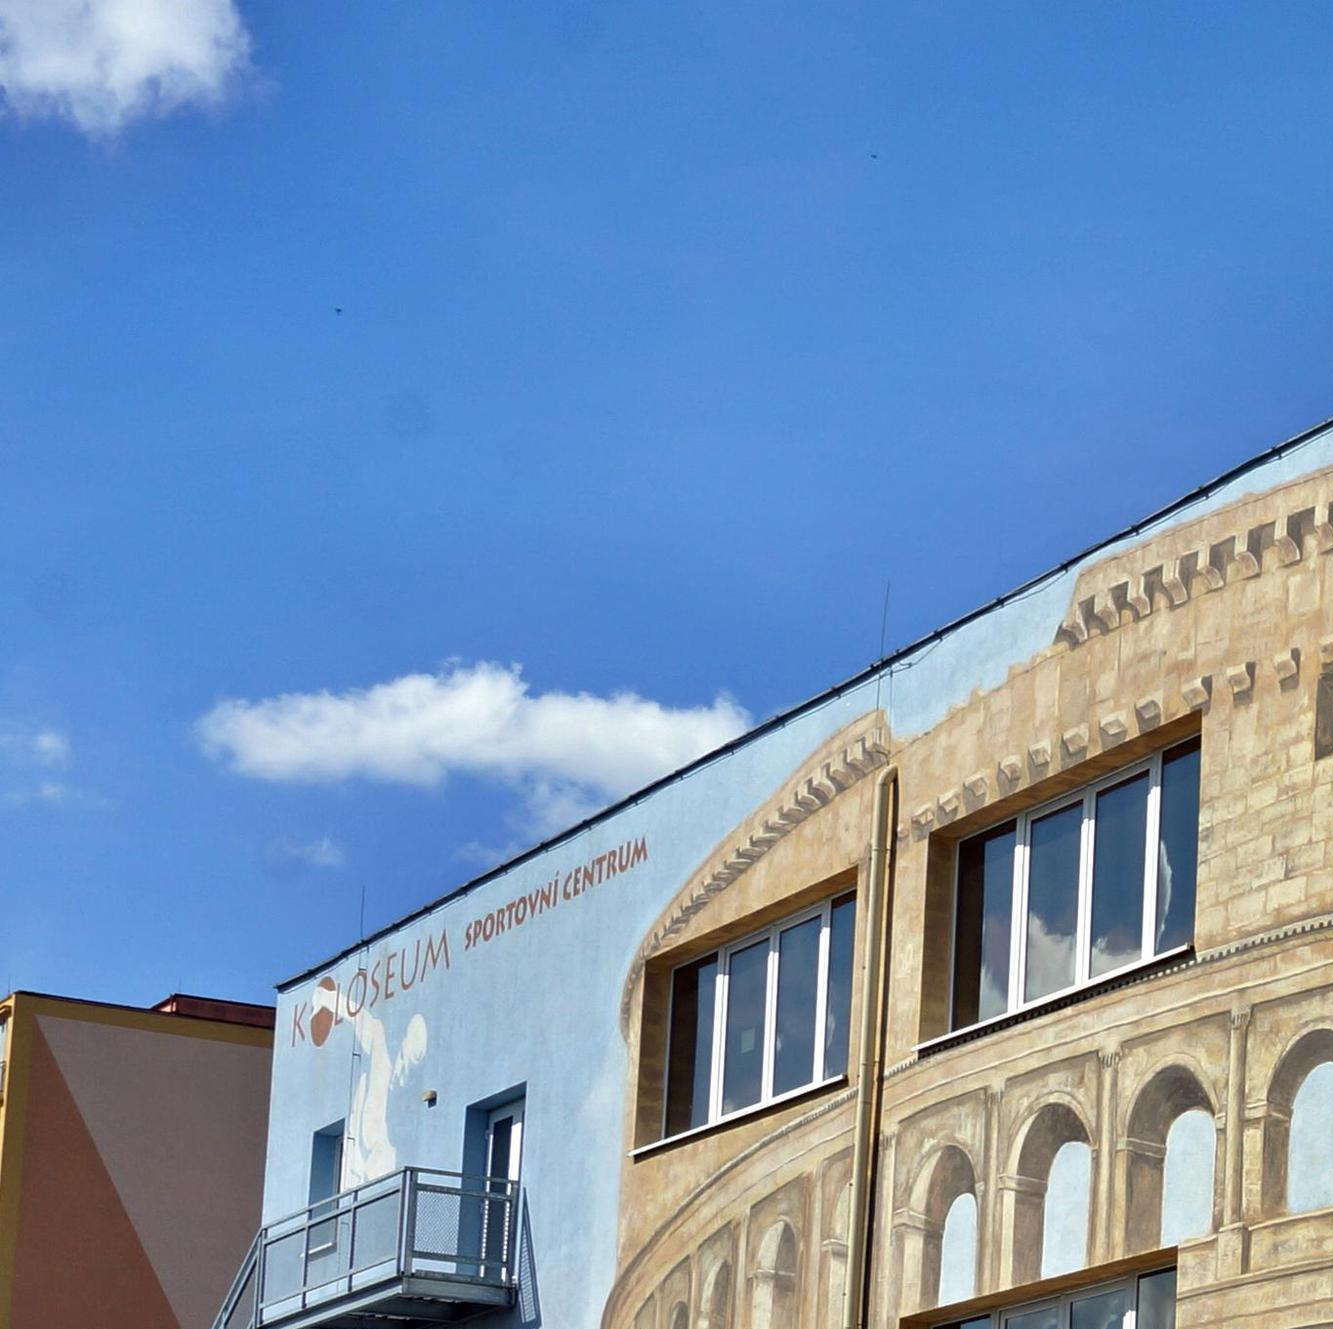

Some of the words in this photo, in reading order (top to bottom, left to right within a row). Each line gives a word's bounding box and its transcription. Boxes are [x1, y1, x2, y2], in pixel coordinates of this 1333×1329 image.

[291, 929, 450, 1047] KOLOSEUM
[465, 870, 559, 951] SPORTOVNÍ
[563, 836, 648, 900] CENTRUM
